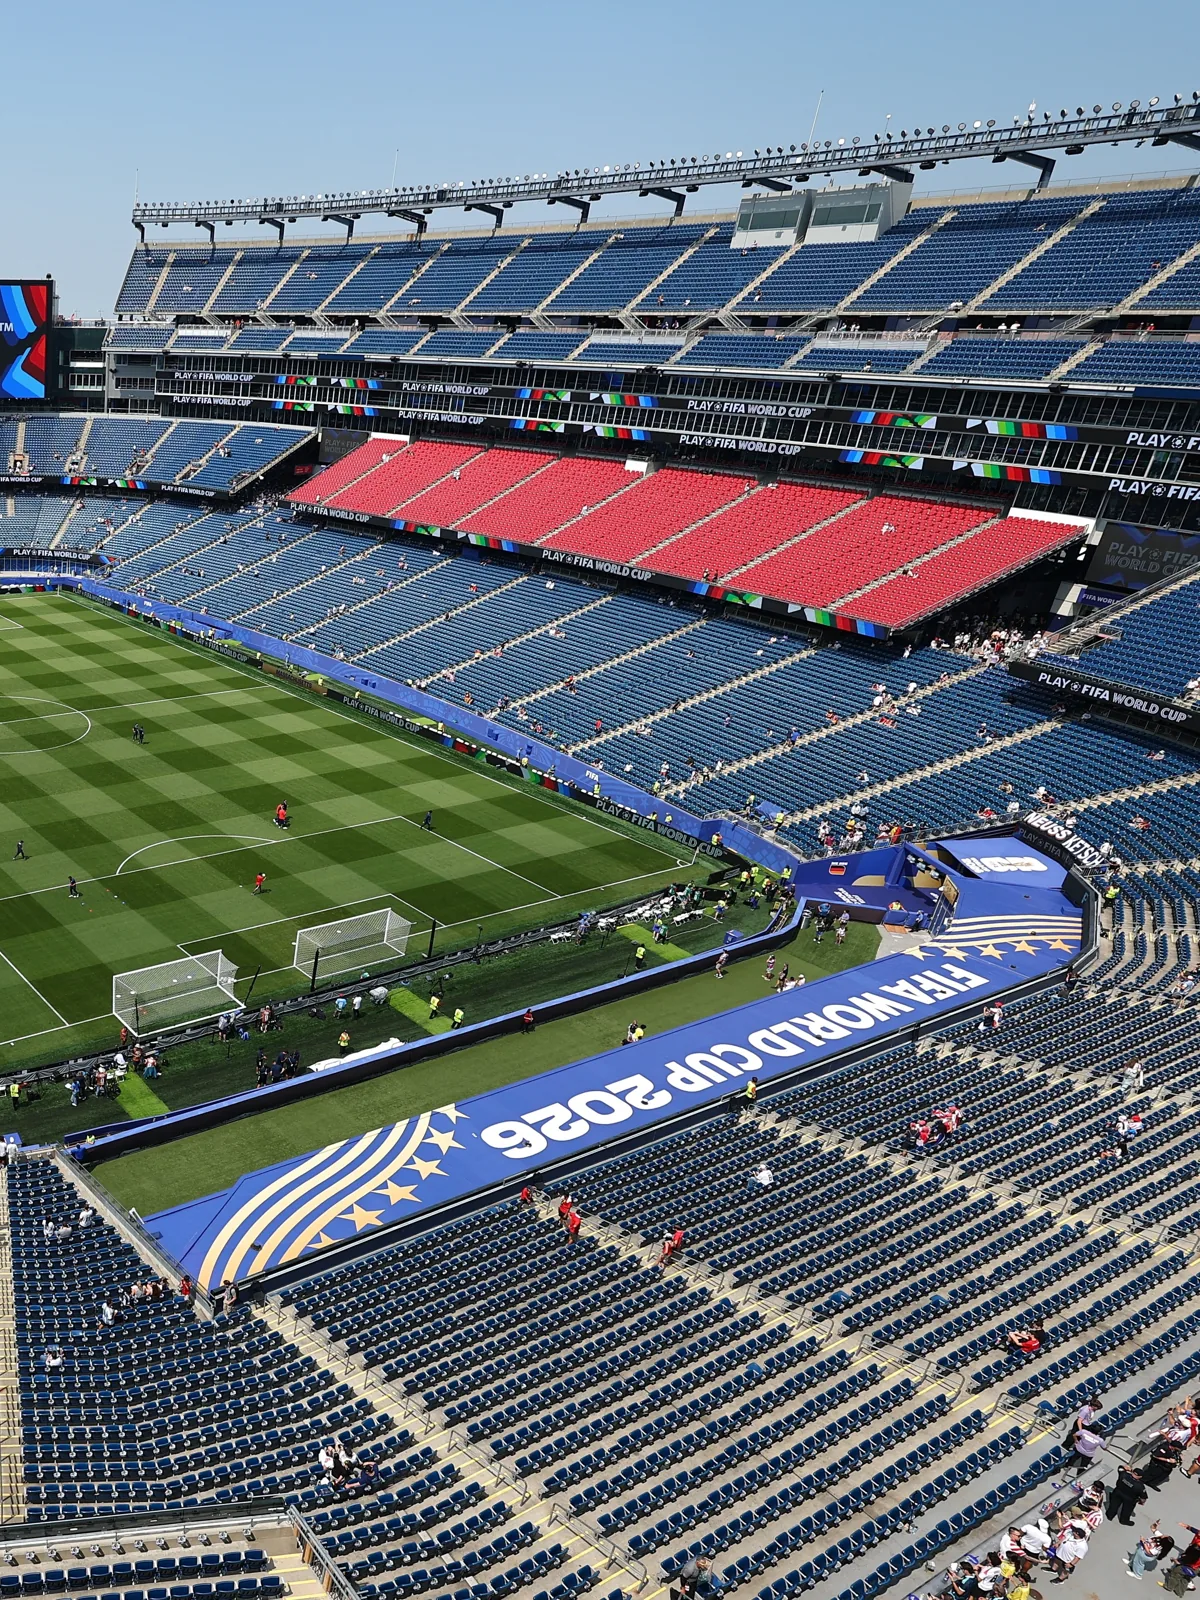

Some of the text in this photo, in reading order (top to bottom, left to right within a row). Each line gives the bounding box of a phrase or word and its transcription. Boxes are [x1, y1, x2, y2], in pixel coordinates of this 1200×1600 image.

[402, 383, 421, 391] PLAY
[428, 384, 444, 392] FIFA
[445, 385, 472, 394] WORLD
[398, 411, 417, 419] PLAY
[424, 412, 440, 421] FIFA
[440, 414, 467, 423] WORLD
[688, 400, 714, 411] PLAY
[722, 402, 746, 414] FIFA
[748, 404, 787, 417] WORLD
[680, 435, 705, 446] PLAY
[714, 438, 736, 449] FIFA
[738, 441, 777, 453] WORLD
[1126, 432, 1172, 448] PLAY
[1108, 479, 1152, 495] PLAY
[290, 503, 307, 512] PLAY
[313, 507, 328, 515] FIFA
[330, 509, 354, 520] WORLD
[54, 551, 78, 559] WORLD
[1108, 542, 1149, 558] PLAY
[542, 550, 566, 562] PLAY
[574, 557, 594, 569] FIFA
[596, 561, 630, 577] WORLD
[1105, 554, 1160, 573] WORLD
[1038, 672, 1070, 689] PLAY
[1082, 685, 1110, 701] FIFA
[1112, 692, 1159, 715] WORLD
[343, 696, 359, 709] PLAY
[364, 706, 379, 717] FIFA
[380, 711, 405, 728] WORLD
[586, 770, 599, 782] FIFA
[596, 800, 621, 816] PLAY
[632, 814, 655, 831] FIFA
[657, 824, 698, 848] WORLD
[1024, 812, 1072, 841] NEUSS
[1062, 834, 1105, 868] KETSCH
[480, 963, 990, 1159] FIFA WORLD CUP 2026
